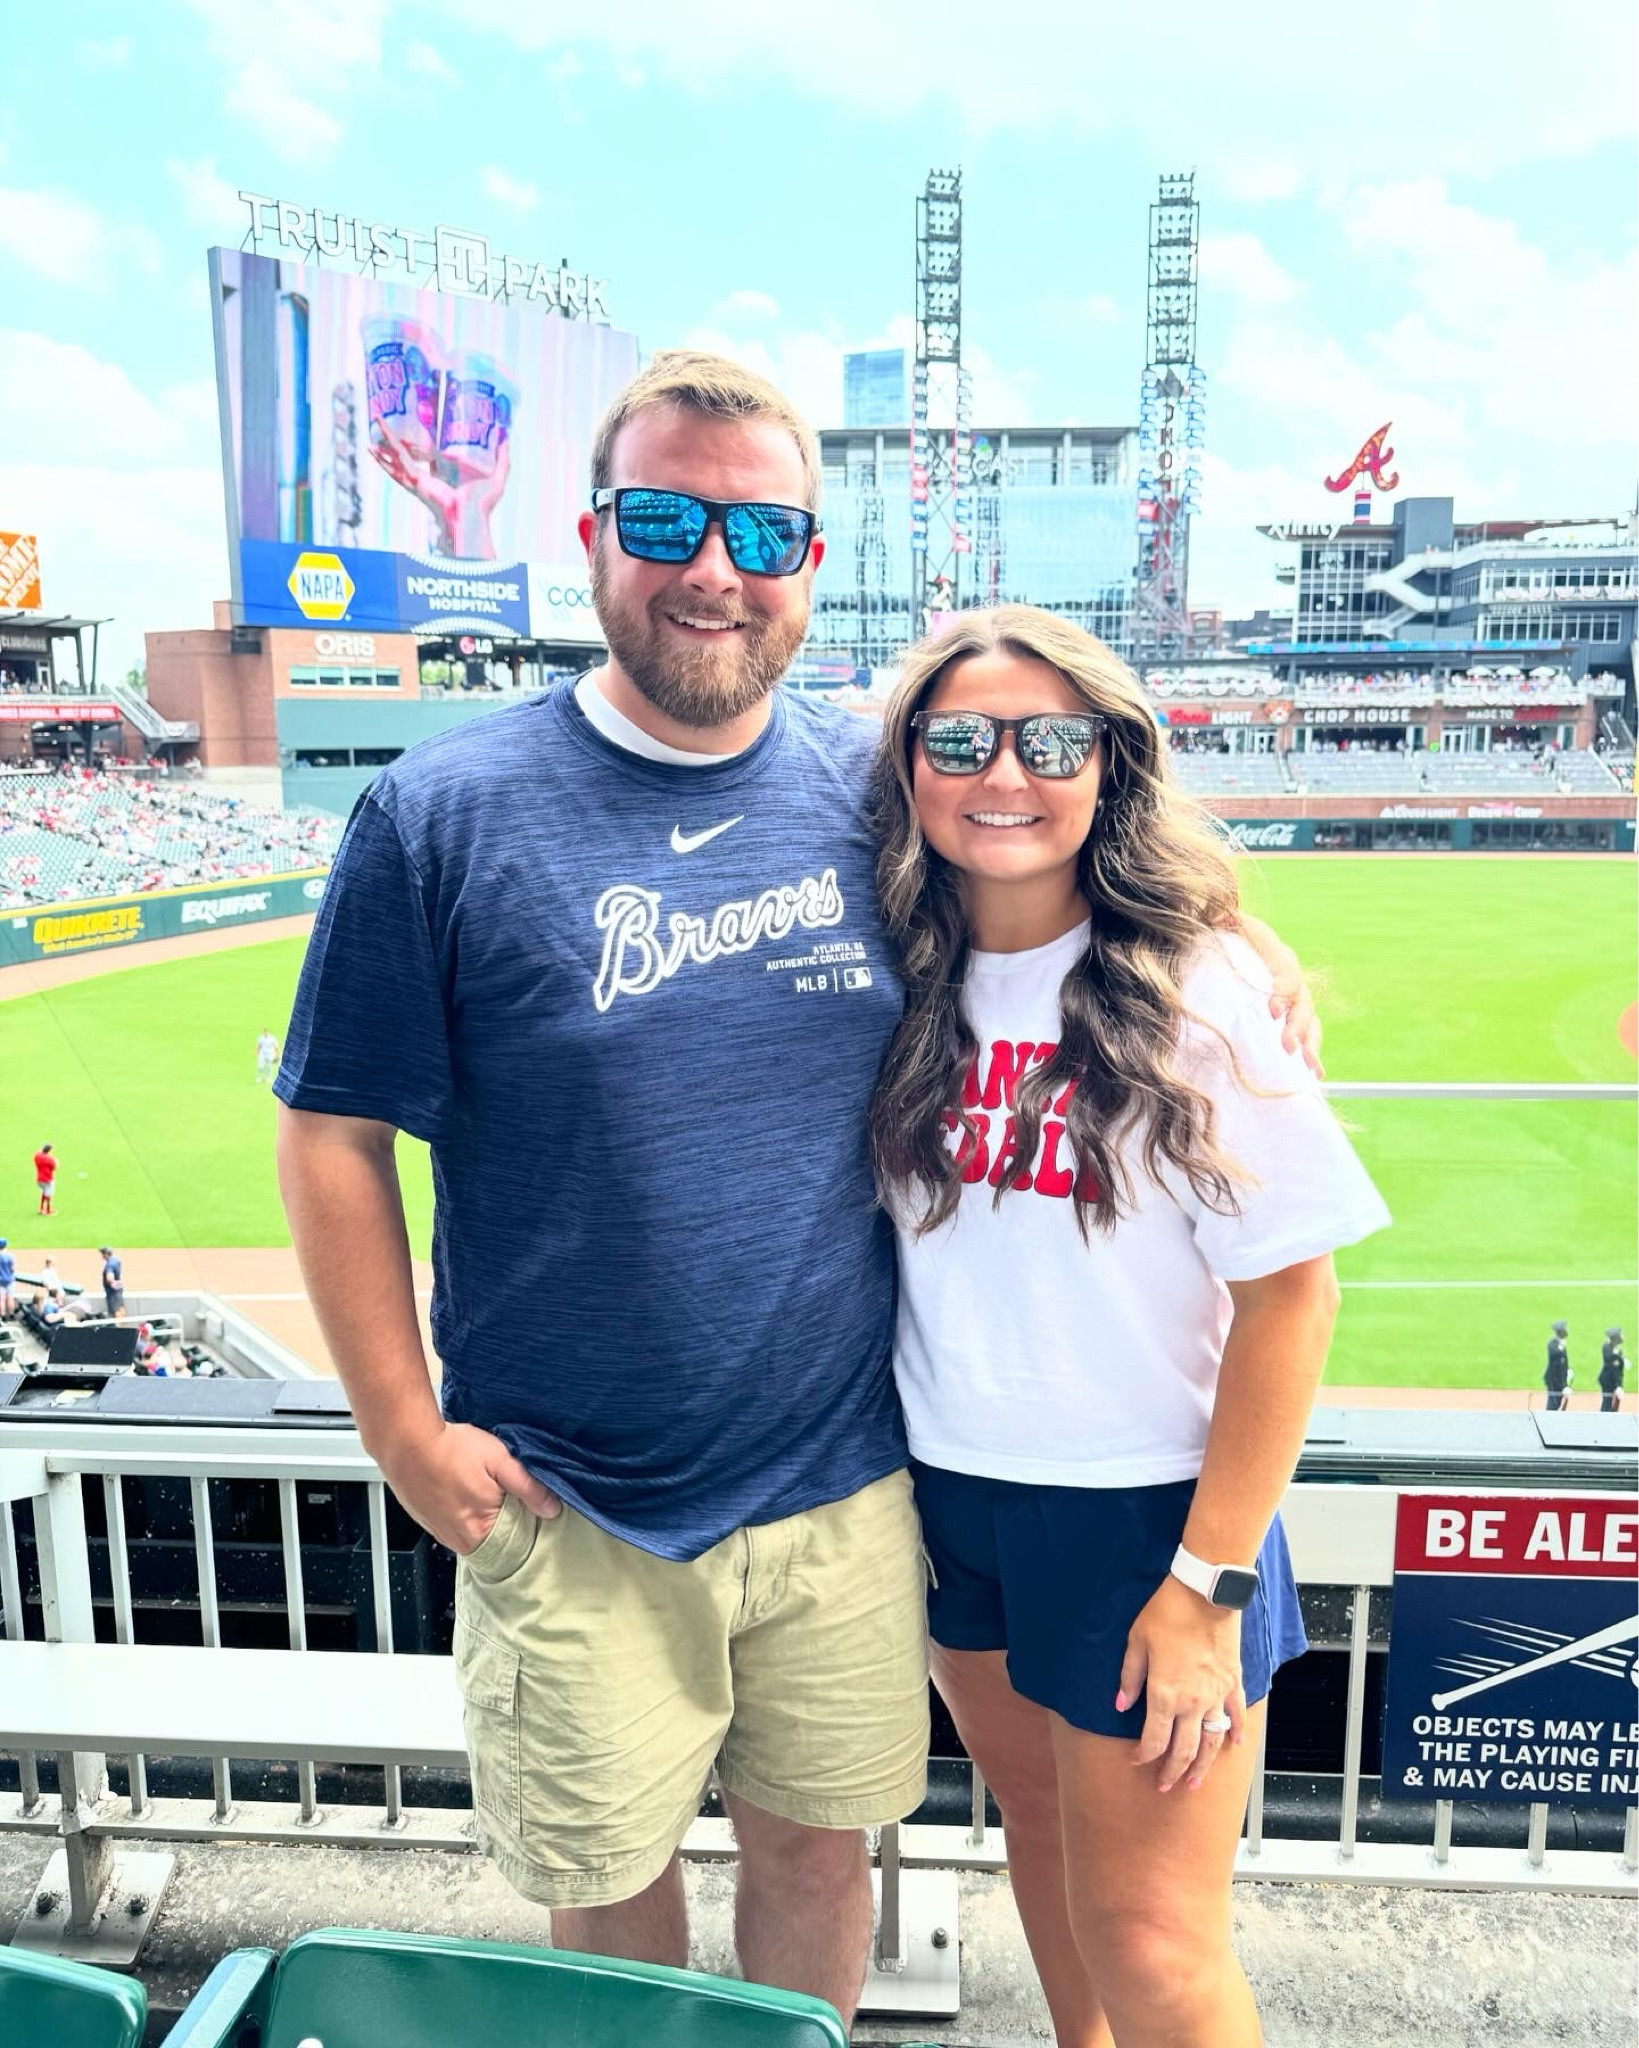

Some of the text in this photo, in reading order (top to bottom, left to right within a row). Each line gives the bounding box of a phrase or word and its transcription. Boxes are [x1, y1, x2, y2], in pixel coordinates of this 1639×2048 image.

[238, 191, 612, 317] TRUIST PARK
[1267, 519, 1342, 541] xfinity
[0, 533, 36, 600] OME
[298, 573, 347, 601] NAPA
[407, 577, 521, 602] NORTHSIDE
[428, 598, 502, 614] HOSPITAL
[315, 634, 376, 657] ORIS
[1212, 710, 1253, 725] LIGHT
[1304, 708, 1411, 723] CHOP HOUSE
[181, 892, 271, 924] EQUIFAX
[34, 906, 143, 943] QUIKRETE
[593, 868, 844, 1012] Braves
[766, 956, 818, 972] AUTHENTIC
[796, 975, 828, 993] MLB
[1425, 1509, 1638, 1563] BE ALE
[1412, 1715, 1535, 1739] OBJECTS
[1543, 1719, 1604, 1742] MAY
[1418, 1741, 1471, 1763] THE
[1480, 1742, 1600, 1767] PLAYING
[1402, 1766, 1424, 1787] &
[1433, 1768, 1493, 1789] MAY
[1500, 1770, 1592, 1792] CAUSE
